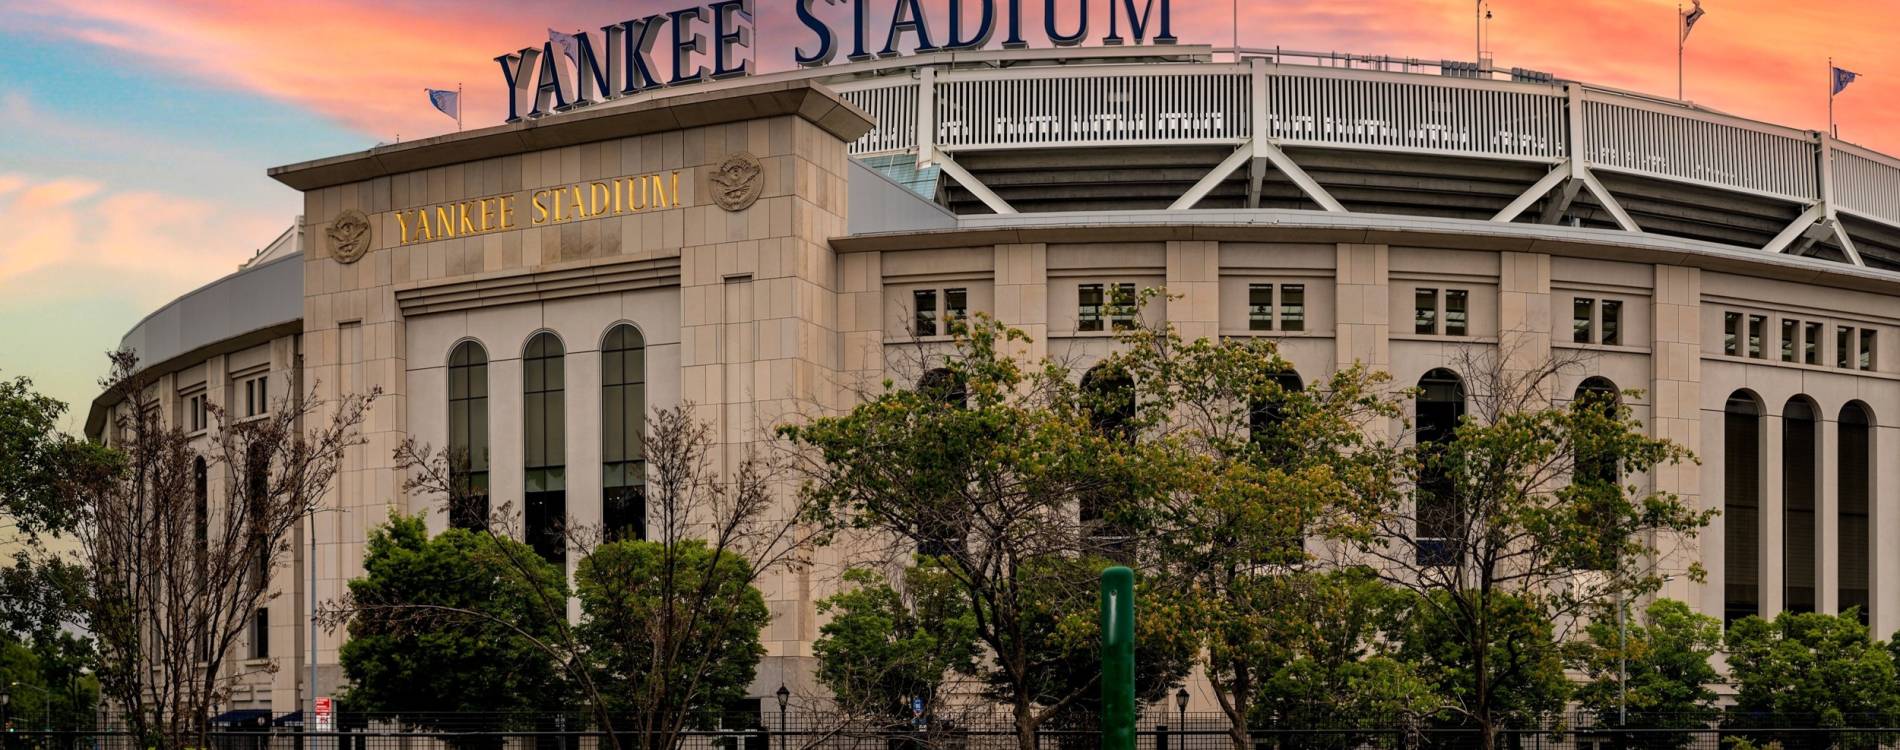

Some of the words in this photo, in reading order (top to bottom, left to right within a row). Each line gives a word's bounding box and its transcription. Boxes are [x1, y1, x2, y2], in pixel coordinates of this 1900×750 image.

[494, 0, 750, 122] YANKEE
[795, 0, 1178, 66] STADIUM
[396, 194, 515, 244] YANKEE
[531, 170, 681, 225] STADIUM
